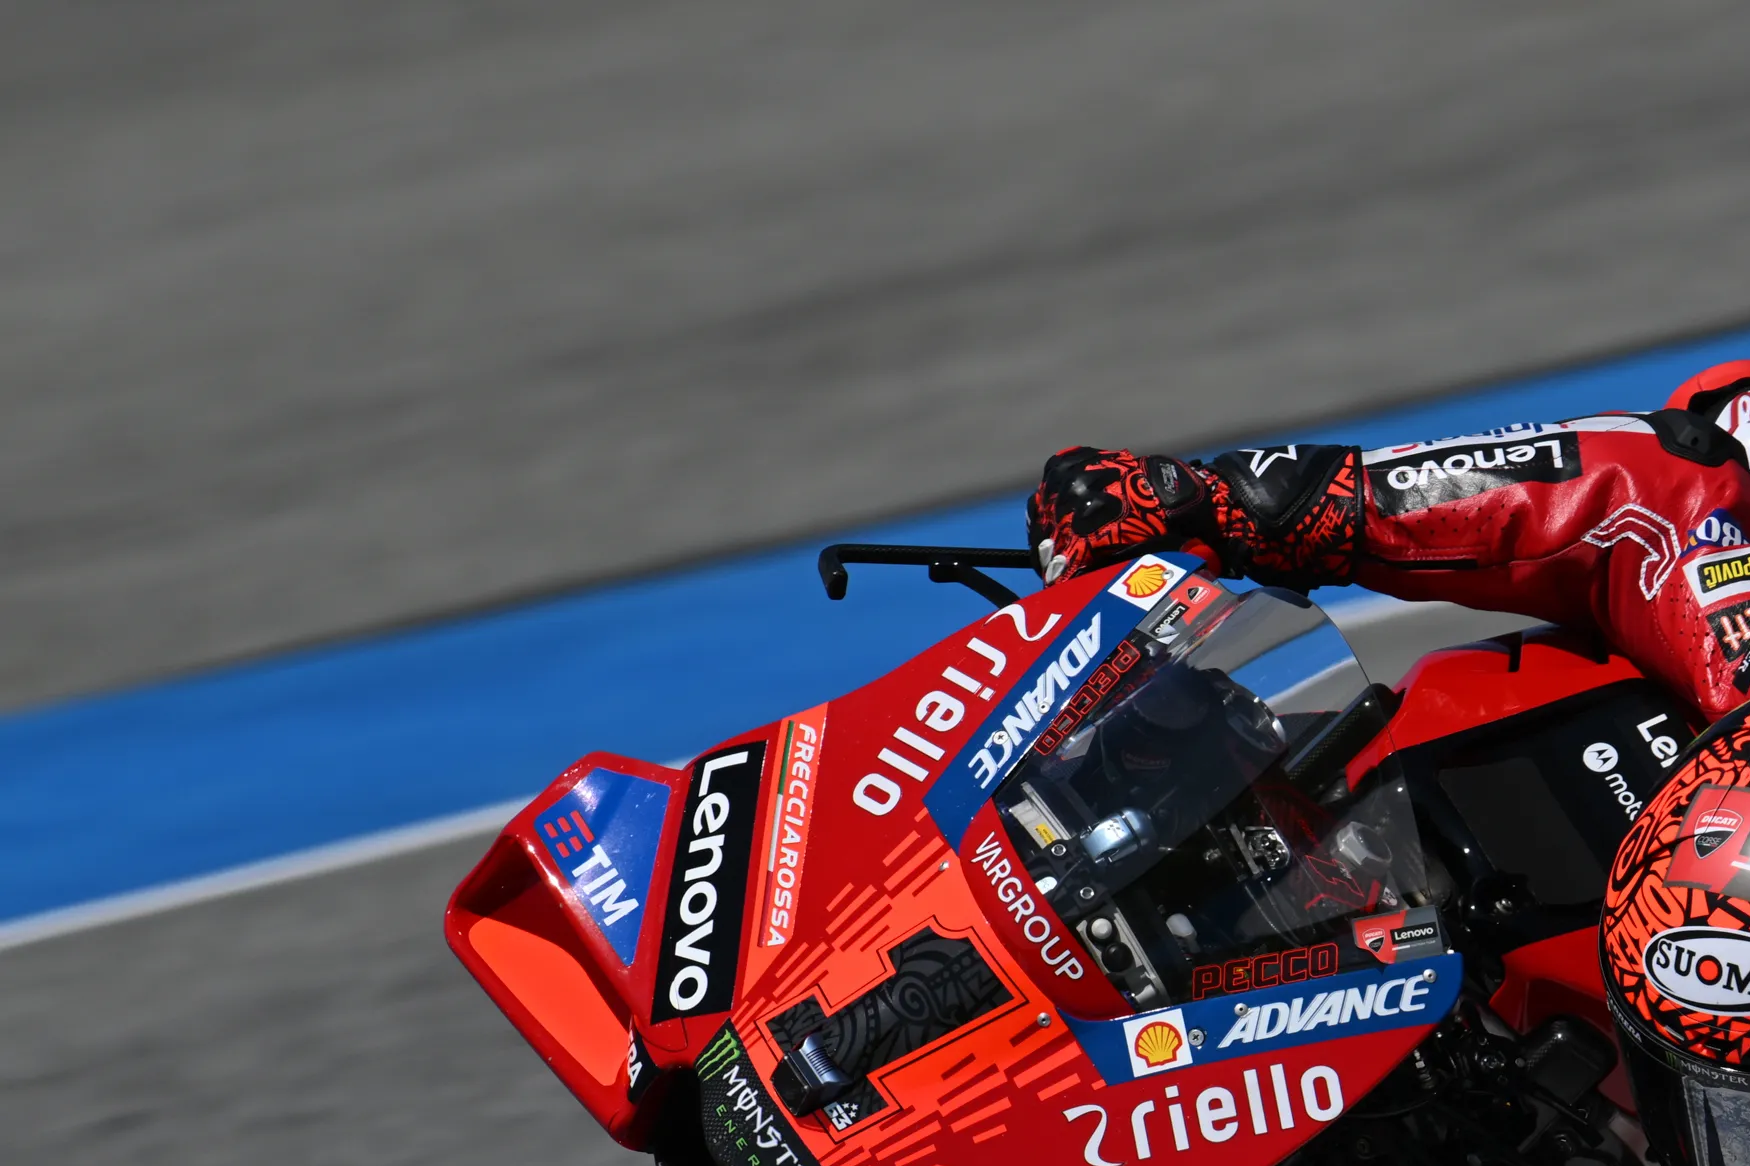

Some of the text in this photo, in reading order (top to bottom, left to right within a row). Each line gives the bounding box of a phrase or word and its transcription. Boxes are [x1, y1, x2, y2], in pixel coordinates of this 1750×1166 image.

[1387, 440, 1564, 490] Lenovo
[852, 637, 1007, 816] riello
[968, 612, 1102, 789] ADVANCE
[1034, 640, 1141, 757] PECCO
[767, 722, 816, 948] FRECCIAROSSA
[1701, 814, 1738, 827] DUCATI
[571, 844, 640, 927] TIM
[668, 751, 749, 1012] Lenovo
[970, 830, 1085, 982] VARGROUP
[1192, 942, 1339, 1000] PECCO
[1394, 927, 1434, 941] Lenovo
[1218, 976, 1430, 1049] ADVANCE
[1130, 1064, 1345, 1160] riello
[1680, 1059, 1749, 1086] MONSTER
